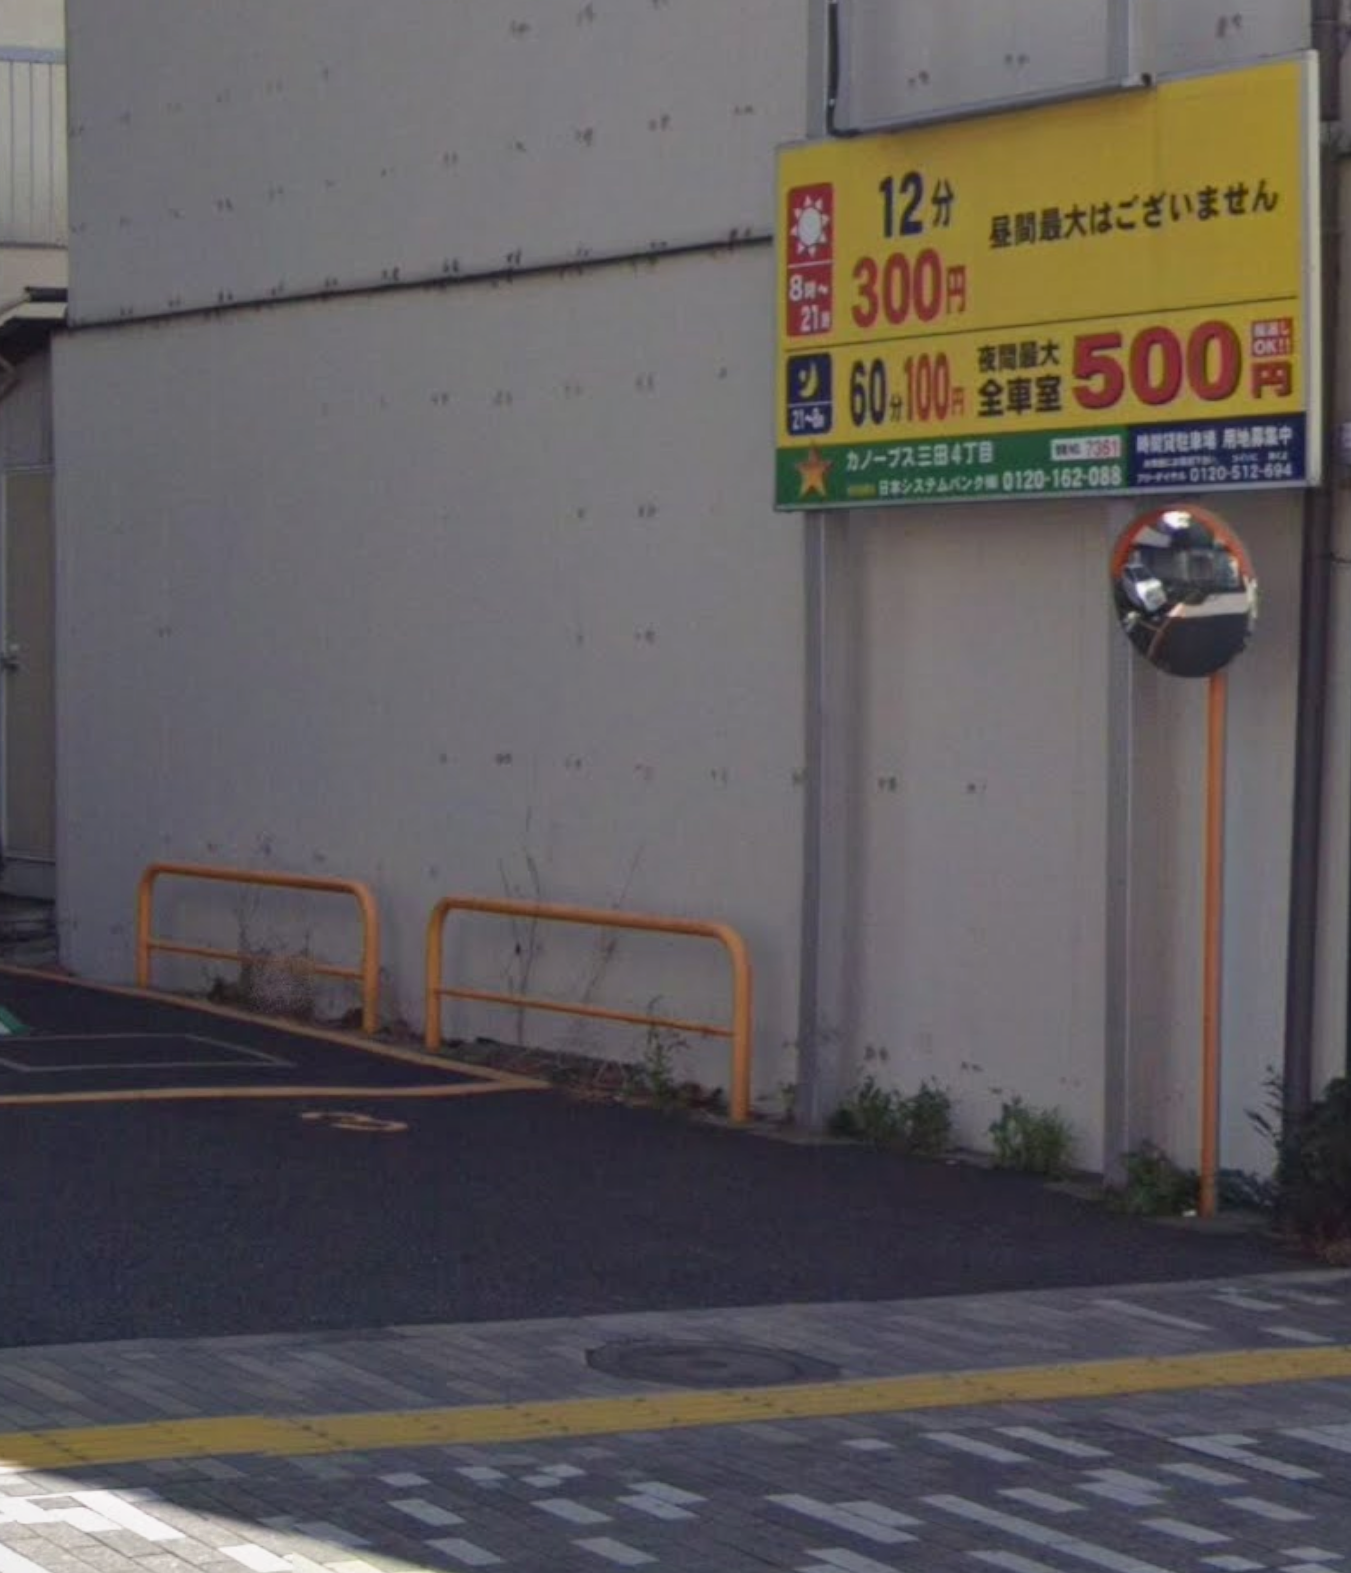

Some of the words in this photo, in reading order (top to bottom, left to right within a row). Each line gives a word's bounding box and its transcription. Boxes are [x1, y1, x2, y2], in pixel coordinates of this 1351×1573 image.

[879, 171, 955, 239] 12分
[989, 178, 1280, 250] 昼間最大はございません
[851, 247, 967, 329] 300円
[977, 339, 1061, 374] 夜間最大
[977, 375, 1063, 418] 全車室
[1001, 464, 1123, 492] 0120-162-088
